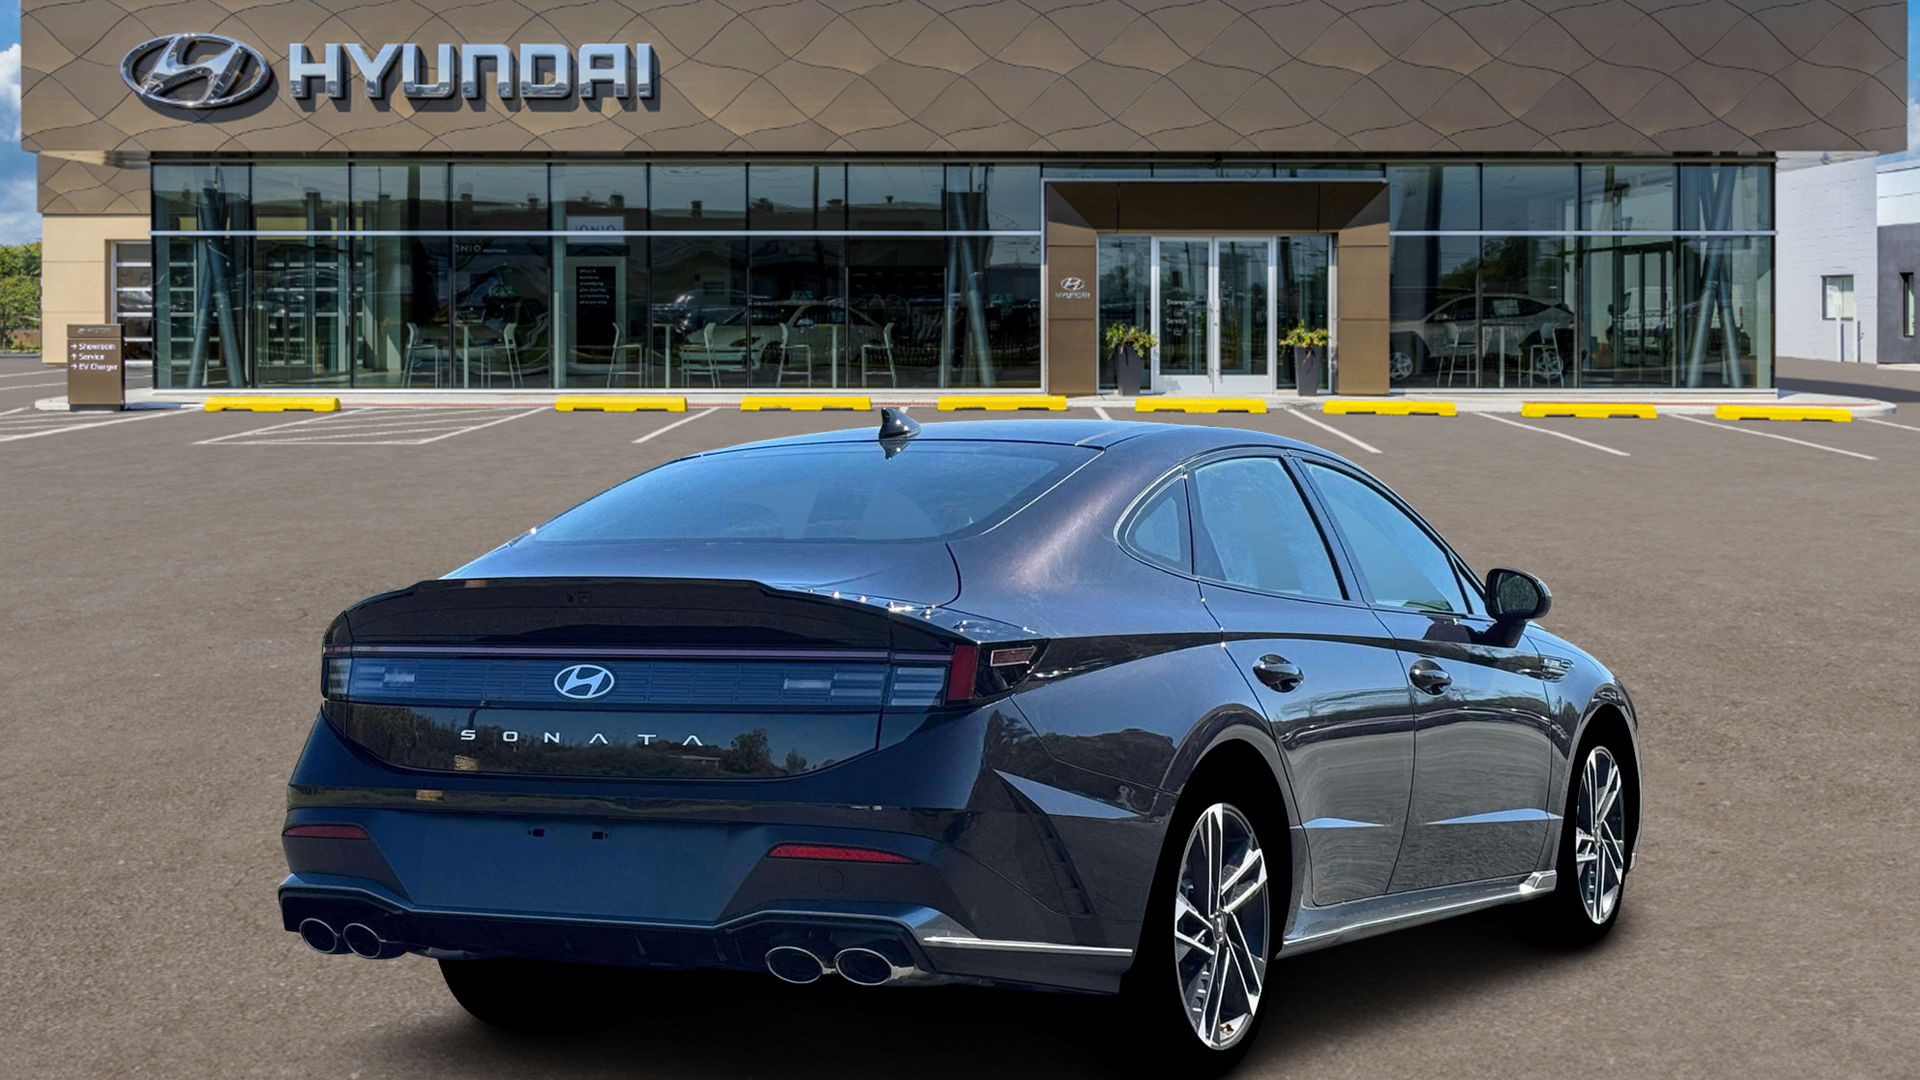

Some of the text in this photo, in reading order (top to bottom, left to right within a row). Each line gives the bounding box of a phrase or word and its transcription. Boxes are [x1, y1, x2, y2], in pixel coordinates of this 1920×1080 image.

[289, 43, 655, 99] HYUNDAI
[79, 352, 105, 360] Service
[90, 363, 118, 372] Charger
[460, 729, 703, 746] SONATA
